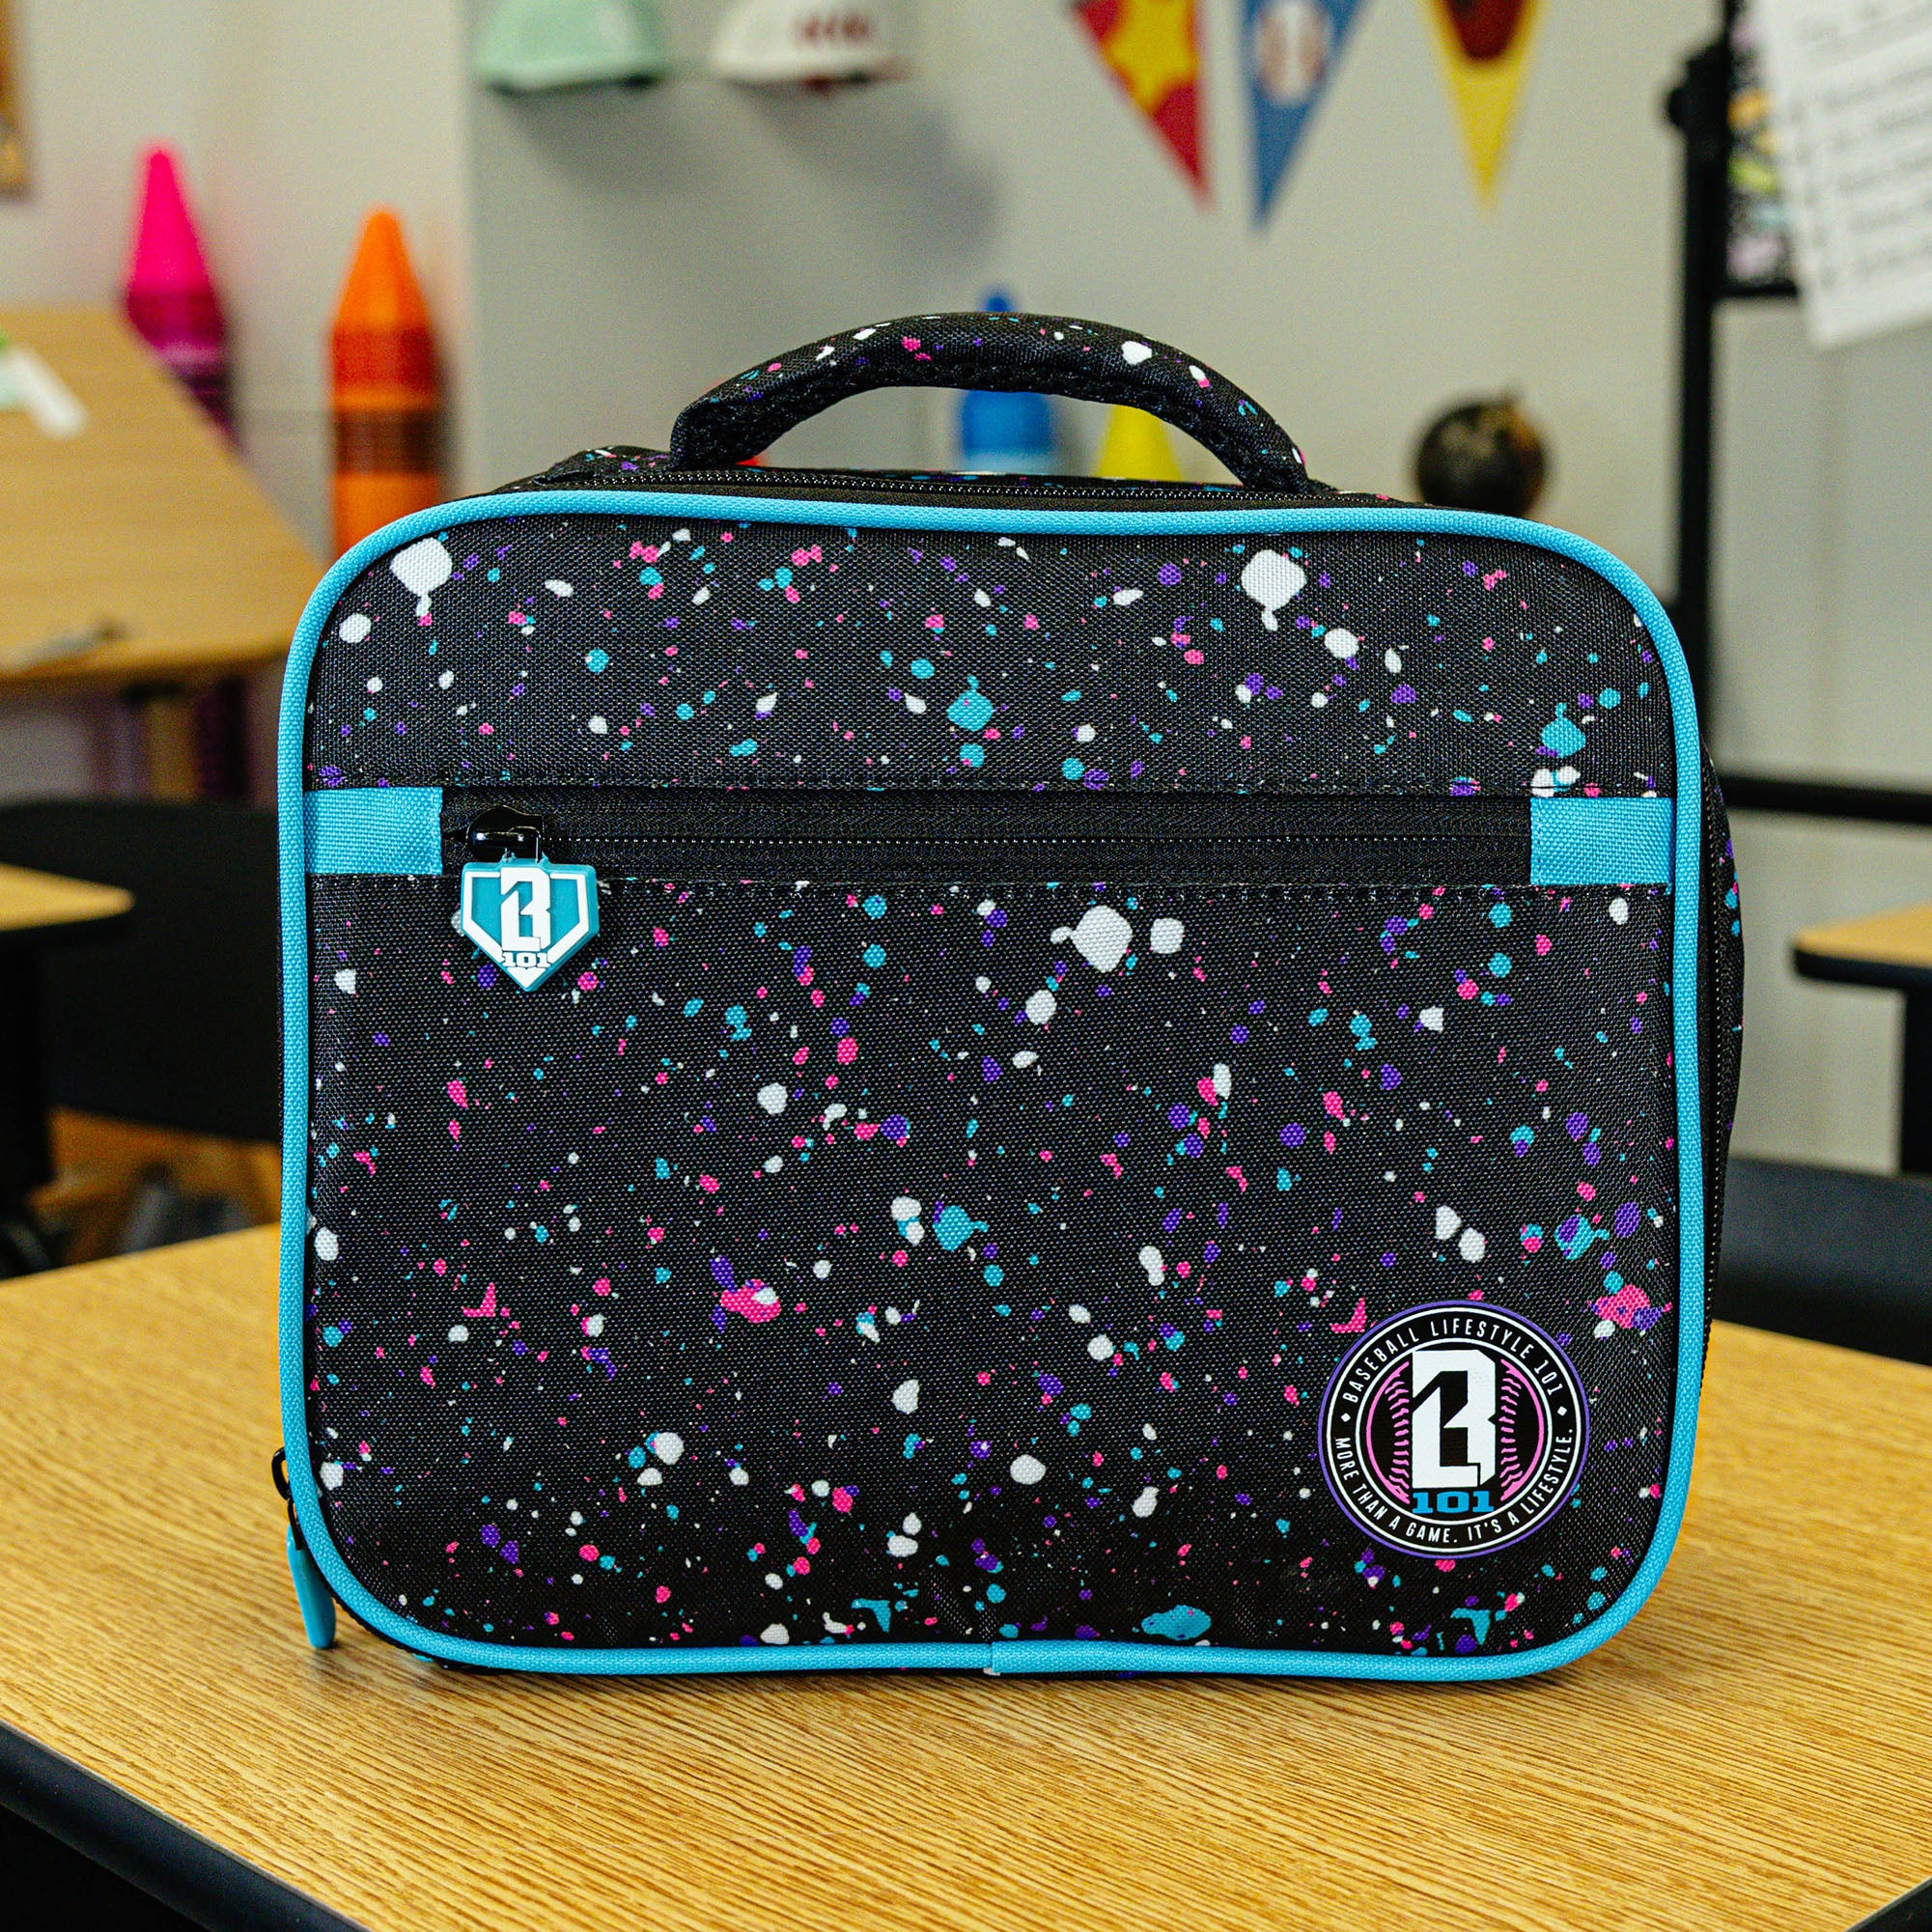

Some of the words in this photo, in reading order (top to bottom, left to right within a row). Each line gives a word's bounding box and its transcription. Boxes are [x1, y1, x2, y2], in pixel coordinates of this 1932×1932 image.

[502, 951, 550, 967] 101
[1342, 1328, 1419, 1404] BASEBALL
[1431, 1318, 1533, 1358] LIFESTYLE
[1534, 1359, 1561, 1396] 101
[1334, 1437, 1359, 1480] MORE
[1353, 1483, 1387, 1521] THAN
[1389, 1516, 1400, 1529] A
[1406, 1523, 1458, 1543] GAME.
[1468, 1519, 1502, 1541] IT'S
[1509, 1512, 1520, 1526] A
[1521, 1428, 1573, 1515] LIFESTYLE.
[1412, 1490, 1495, 1514] 101
